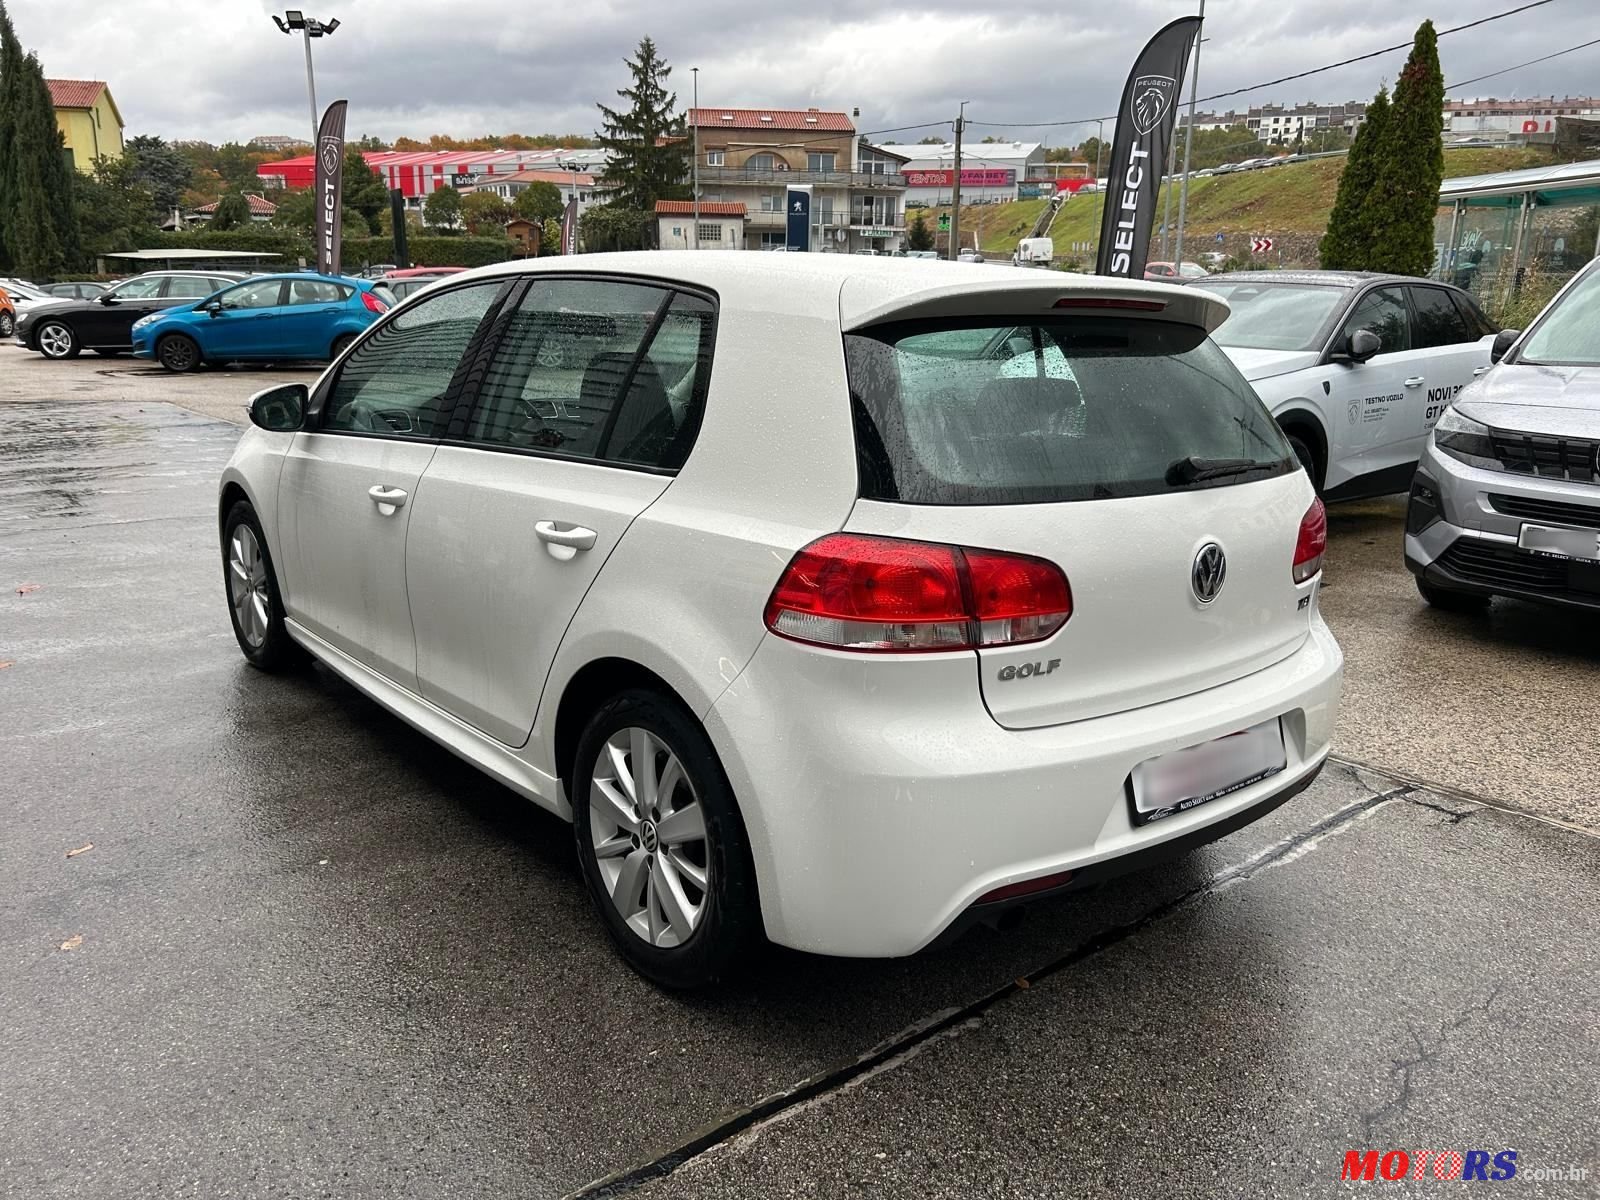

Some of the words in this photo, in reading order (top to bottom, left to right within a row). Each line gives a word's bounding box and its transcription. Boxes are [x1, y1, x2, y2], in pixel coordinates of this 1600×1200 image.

[1137, 79, 1173, 88] PEUGEOT
[908, 173, 947, 184] CENTAR
[1111, 141, 1149, 274] SELECT
[325, 178, 335, 265] SELECT
[1364, 395, 1386, 405] TESTNO
[1386, 393, 1404, 402] VOZILO
[1427, 386, 1452, 402] NOVI
[1425, 405, 1439, 419] GT
[997, 658, 1062, 681] GOLF
